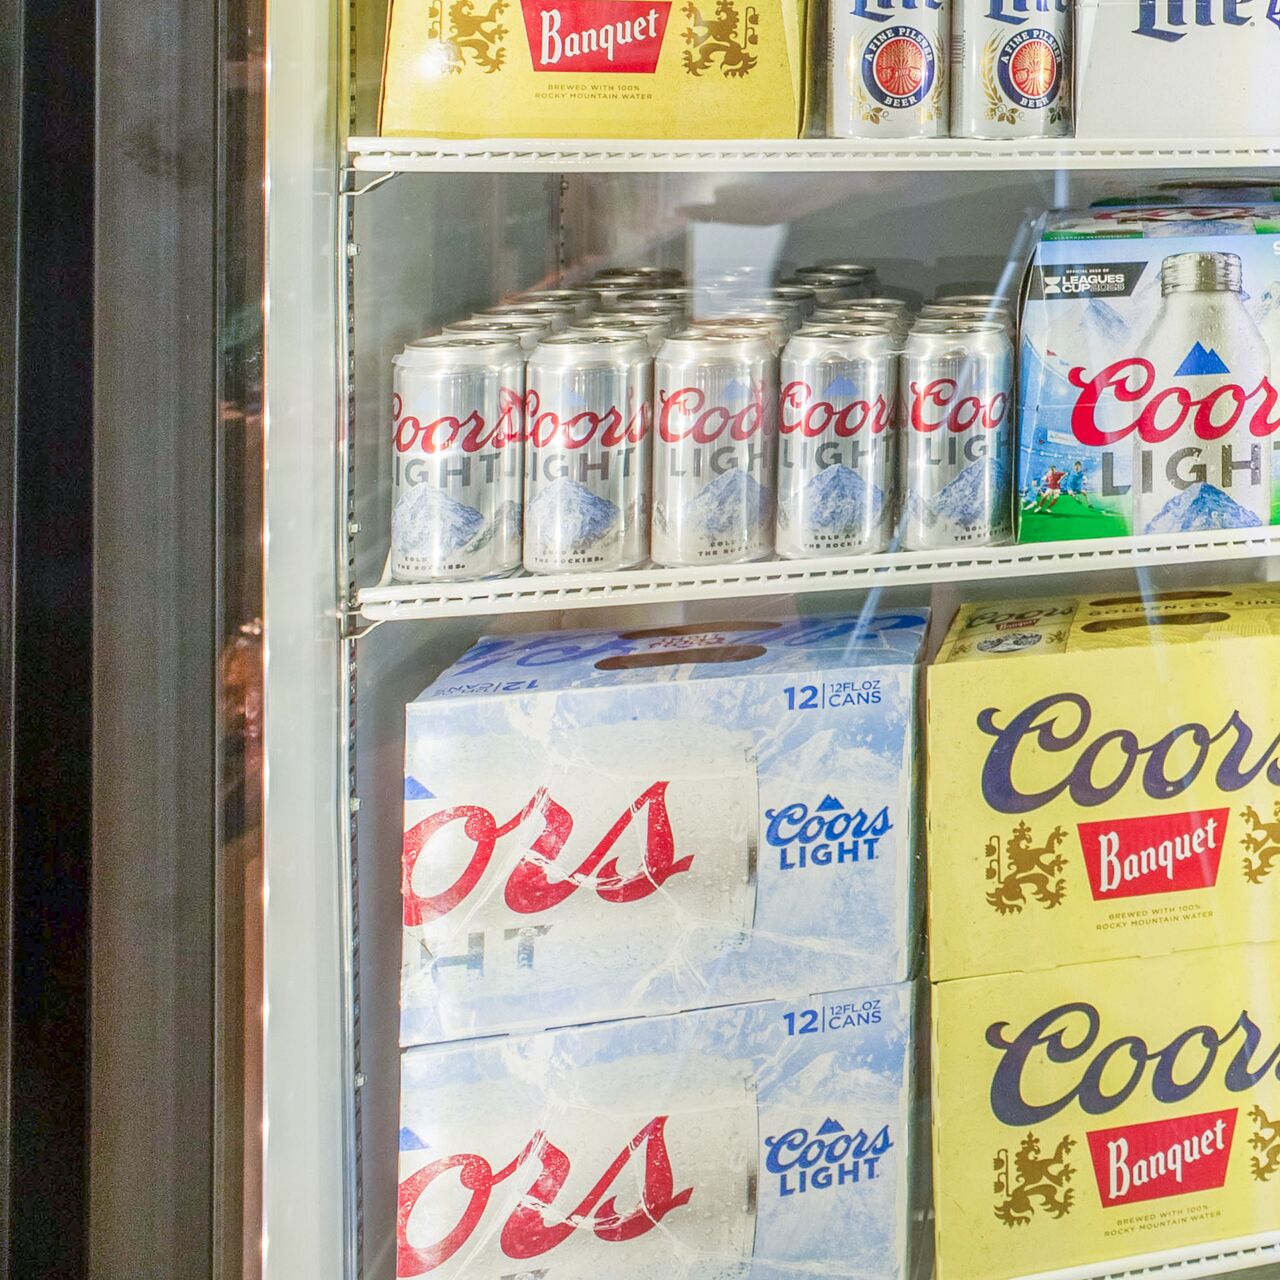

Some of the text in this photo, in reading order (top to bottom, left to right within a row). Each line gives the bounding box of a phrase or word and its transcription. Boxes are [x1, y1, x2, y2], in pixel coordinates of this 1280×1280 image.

[539, 7, 660, 66] Banquet
[864, 27, 933, 62] A FINE PILSNER
[884, 95, 918, 107] BEER
[1062, 274, 1125, 285] LEAGUES
[1062, 281, 1089, 293] CUP
[783, 684, 819, 710] 12
[829, 690, 882, 707] CANS
[765, 802, 894, 849] Coors
[779, 839, 879, 870] LIGHT
[1098, 817, 1219, 894] Banquet
[782, 1010, 819, 1035] 12
[829, 1010, 882, 1030] CANS
[765, 1125, 894, 1174] Coors
[1107, 1119, 1226, 1199] Banquet
[779, 1158, 880, 1197] LIGHT
